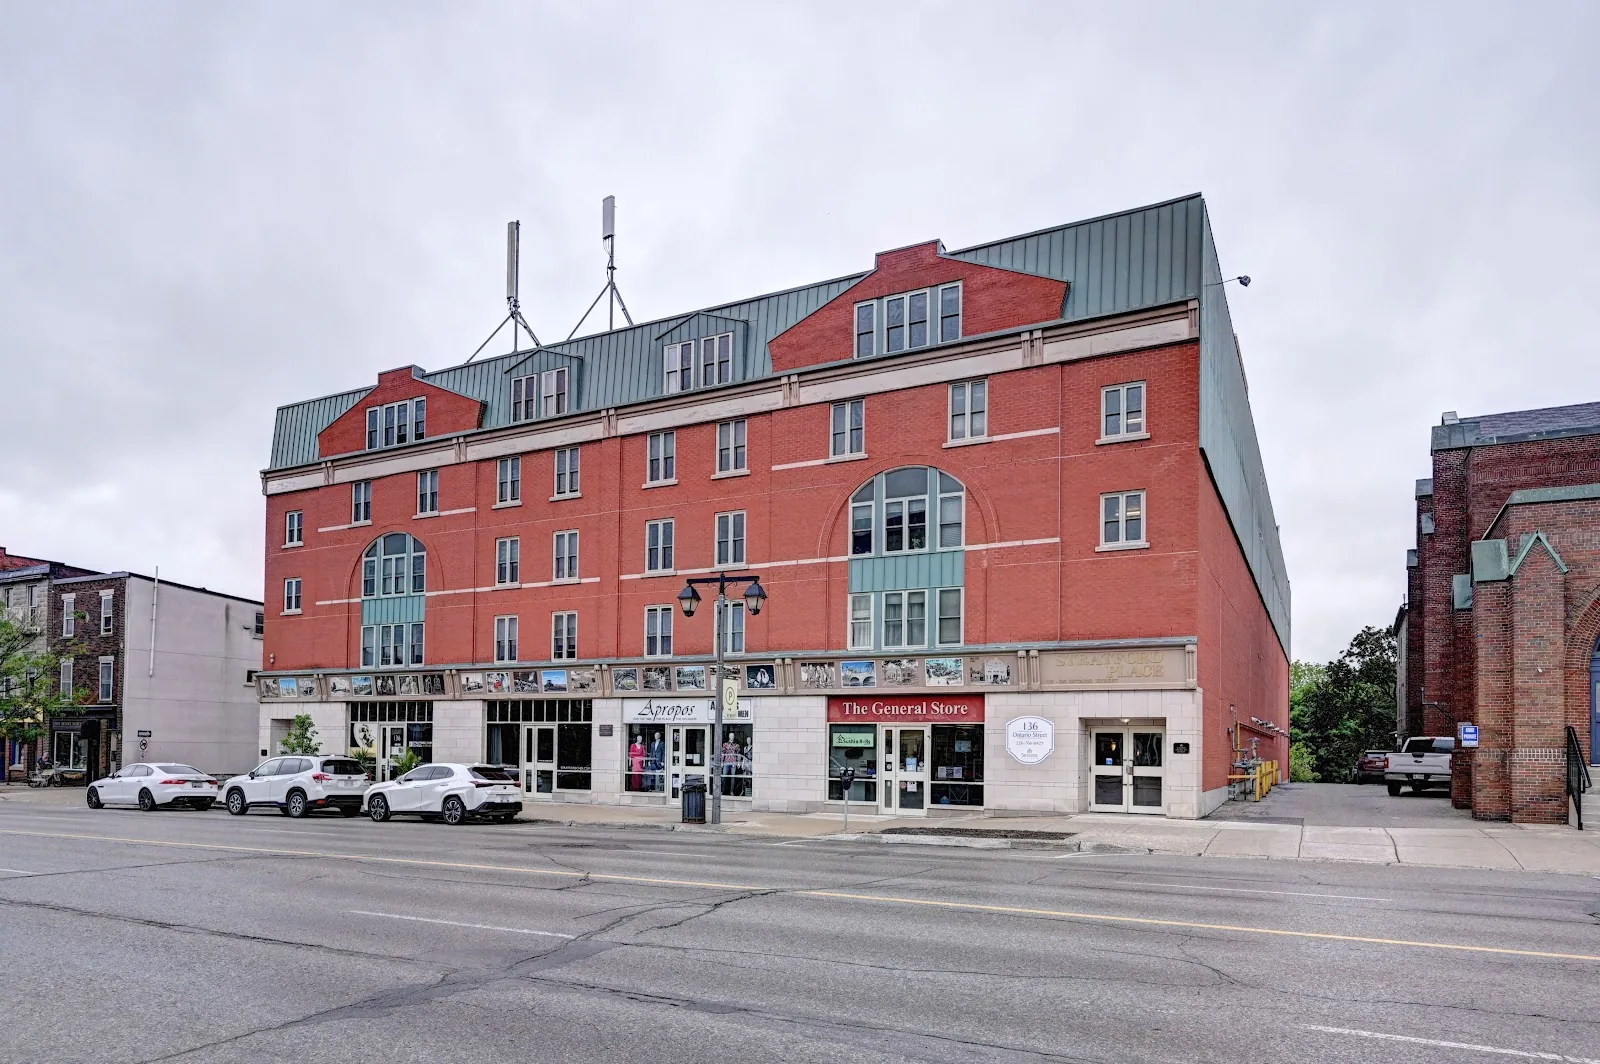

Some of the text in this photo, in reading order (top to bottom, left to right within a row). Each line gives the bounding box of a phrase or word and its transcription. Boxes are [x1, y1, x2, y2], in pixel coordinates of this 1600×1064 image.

[1056, 652, 1164, 667] STRATFORD
[1106, 665, 1164, 679] PLACE
[637, 699, 696, 722] Apropos
[843, 701, 968, 715] The General Store
[1023, 722, 1038, 731] 136
